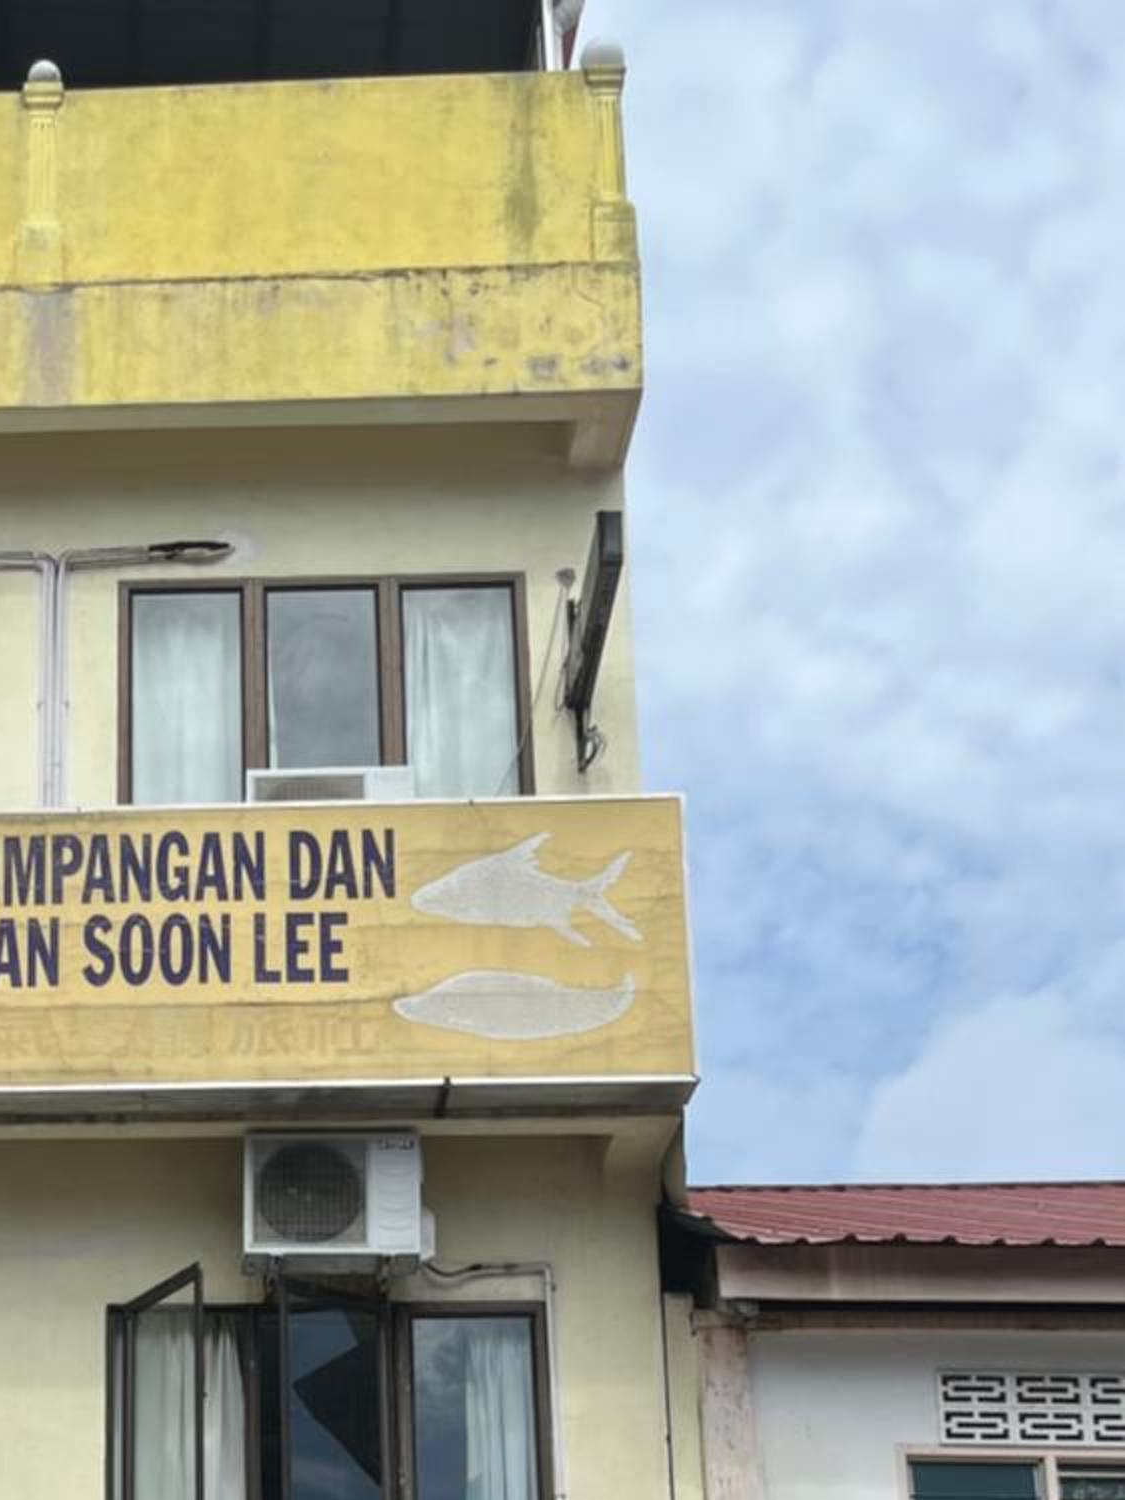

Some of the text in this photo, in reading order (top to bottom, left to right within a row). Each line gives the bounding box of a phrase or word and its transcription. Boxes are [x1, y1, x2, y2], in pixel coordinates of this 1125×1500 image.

[289, 828, 396, 901] DAN
[82, 913, 231, 986] SOON
[253, 911, 349, 983] LEE
